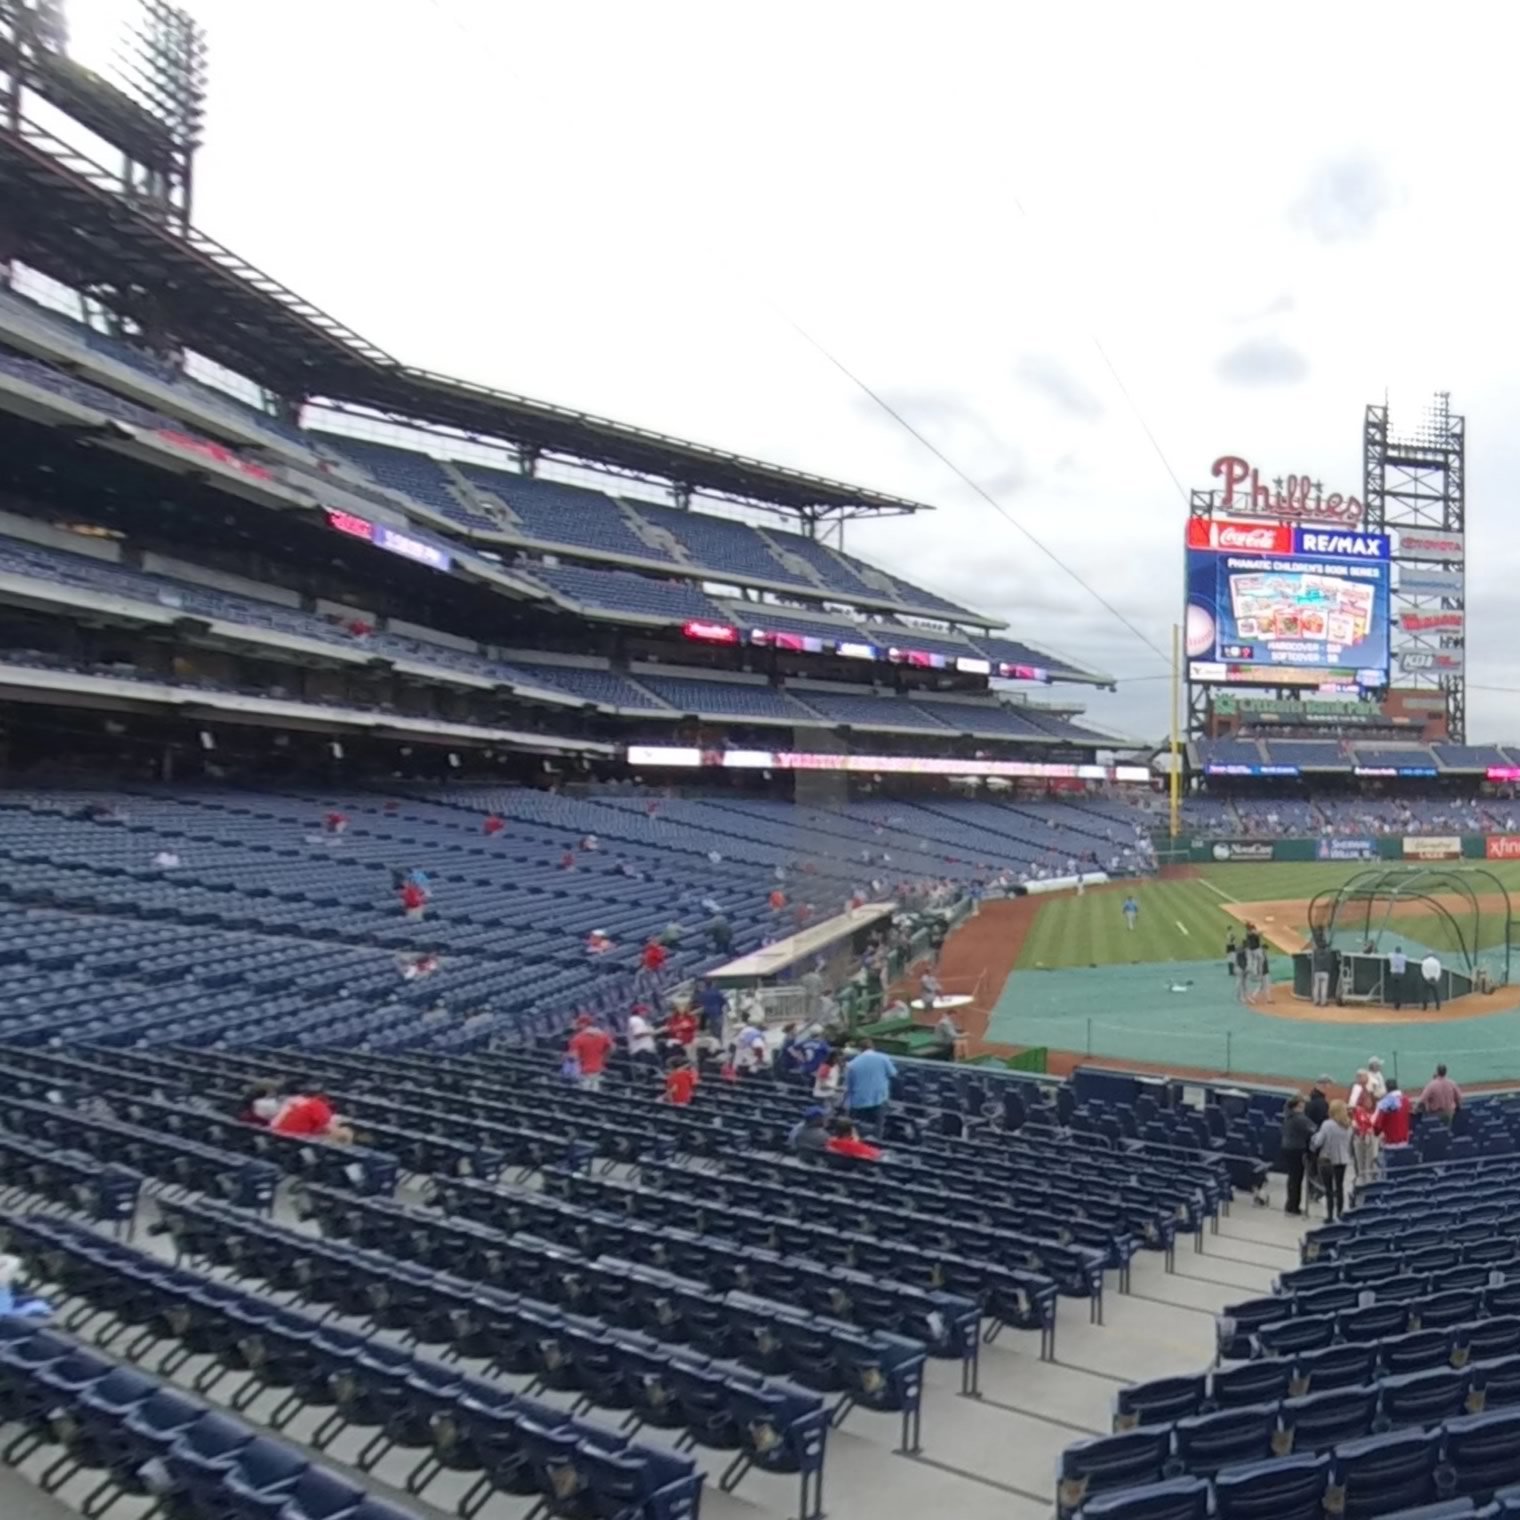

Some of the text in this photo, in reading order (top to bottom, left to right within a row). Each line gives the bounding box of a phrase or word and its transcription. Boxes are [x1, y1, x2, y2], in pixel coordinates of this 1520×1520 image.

[1211, 456, 1363, 521] Phillies
[1303, 534, 1380, 556] RE/MAX
[1273, 560, 1323, 573] CHILDREN'S
[1325, 563, 1348, 575] BOOK
[1239, 698, 1383, 716] Citizens Bank Park
